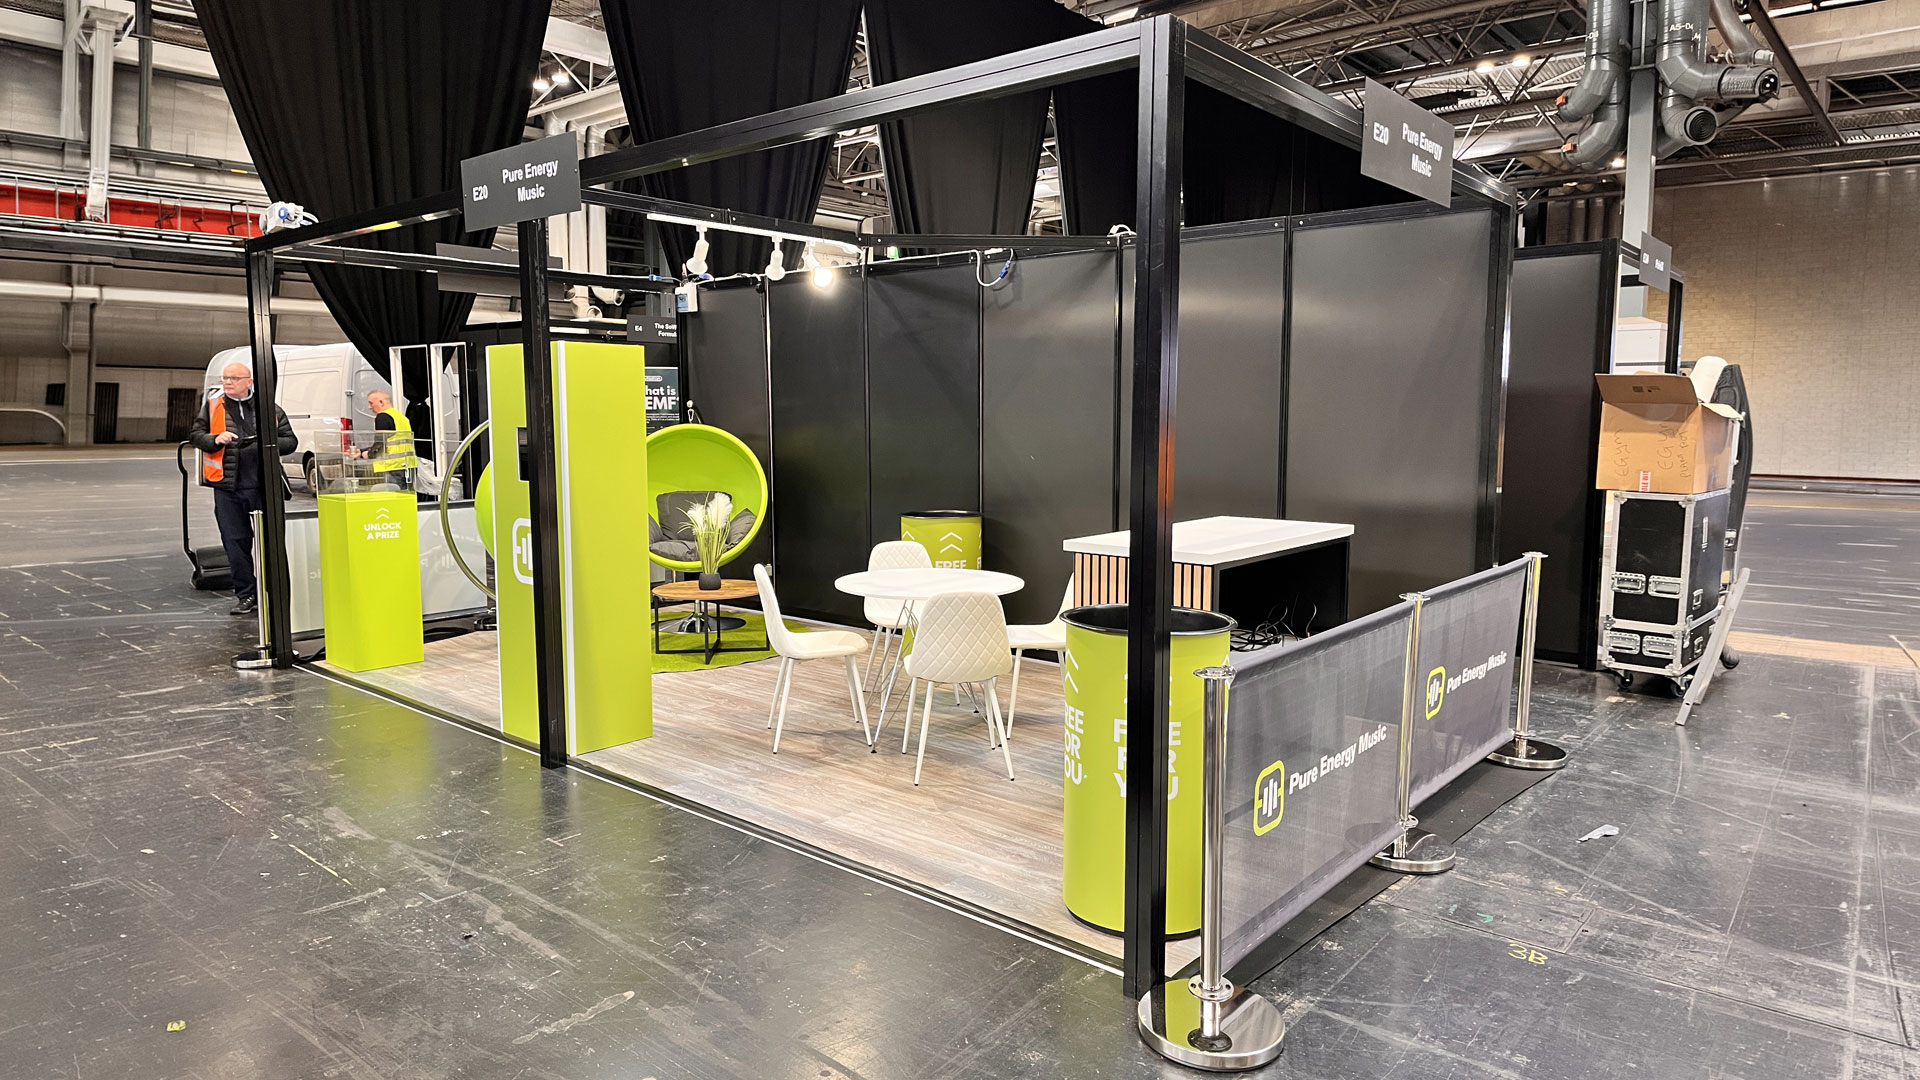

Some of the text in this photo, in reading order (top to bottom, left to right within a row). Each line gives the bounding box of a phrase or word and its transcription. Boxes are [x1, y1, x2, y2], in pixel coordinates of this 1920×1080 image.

[1373, 122, 1389, 145] E20
[1402, 122, 1443, 161] Pure Energy
[502, 160, 558, 184] Pure Energy
[1411, 153, 1432, 178] Music
[472, 184, 488, 201] E20
[517, 183, 545, 202] Music
[645, 384, 676, 395] hat is
[645, 396, 679, 410] EMF
[363, 521, 402, 532] UNLOCK
[367, 530, 400, 540] A PRIZE
[1446, 650, 1507, 694] Pure Energy Music
[1065, 702, 1084, 735] REE
[1113, 718, 1181, 745] FE
[1065, 729, 1081, 760] OR
[1065, 754, 1082, 786] OU
[1117, 746, 1177, 773] FR
[1288, 724, 1387, 795] Pure Energy Music
[1113, 772, 1179, 801] YU
[1507, 943, 1548, 965] 3B
